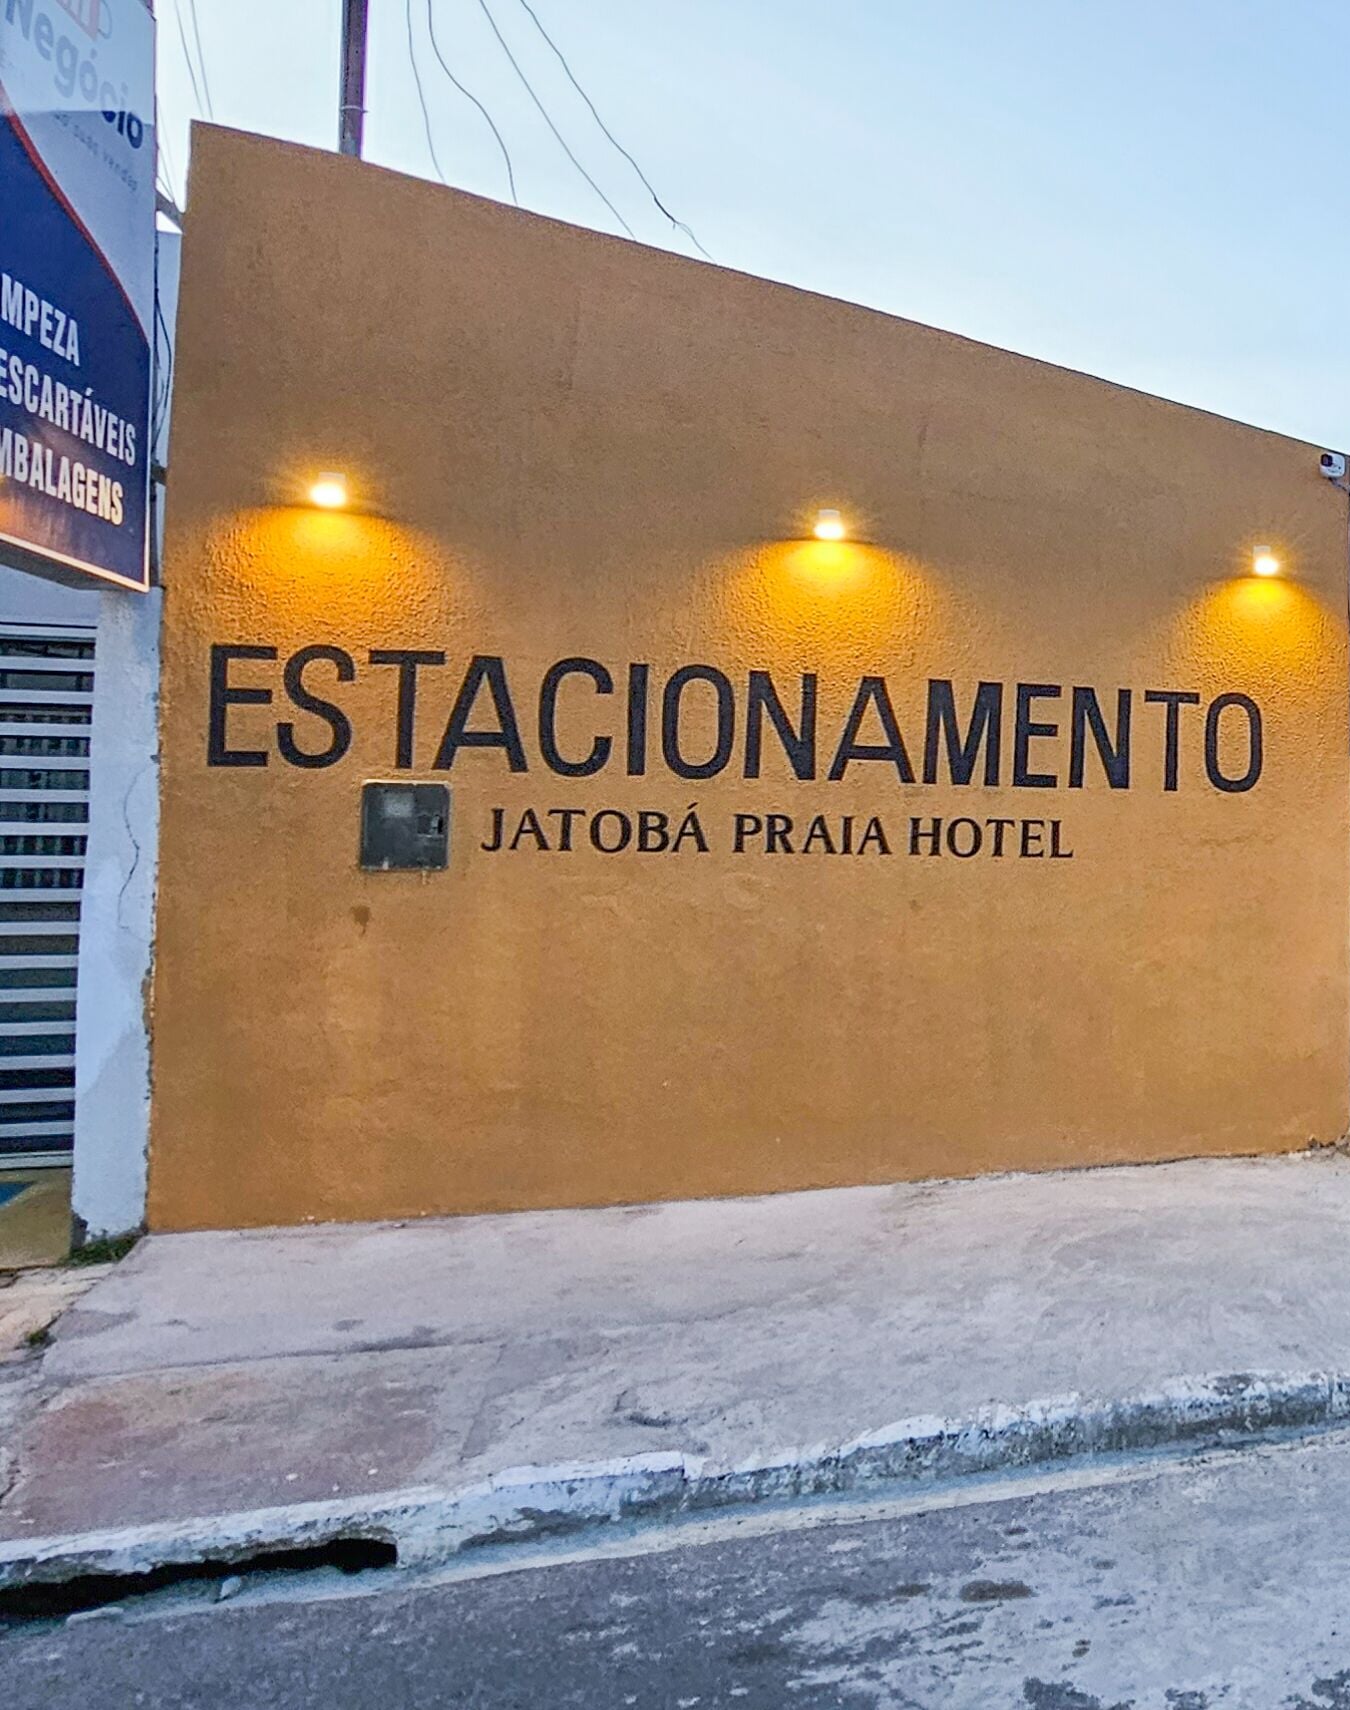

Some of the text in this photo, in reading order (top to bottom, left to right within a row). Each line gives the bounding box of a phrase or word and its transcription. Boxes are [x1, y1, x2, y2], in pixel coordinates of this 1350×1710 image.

[206, 643, 1263, 793] ESTACIONAMENTO
[480, 802, 1073, 858] JATOBÁ PRAIA HOTEL
